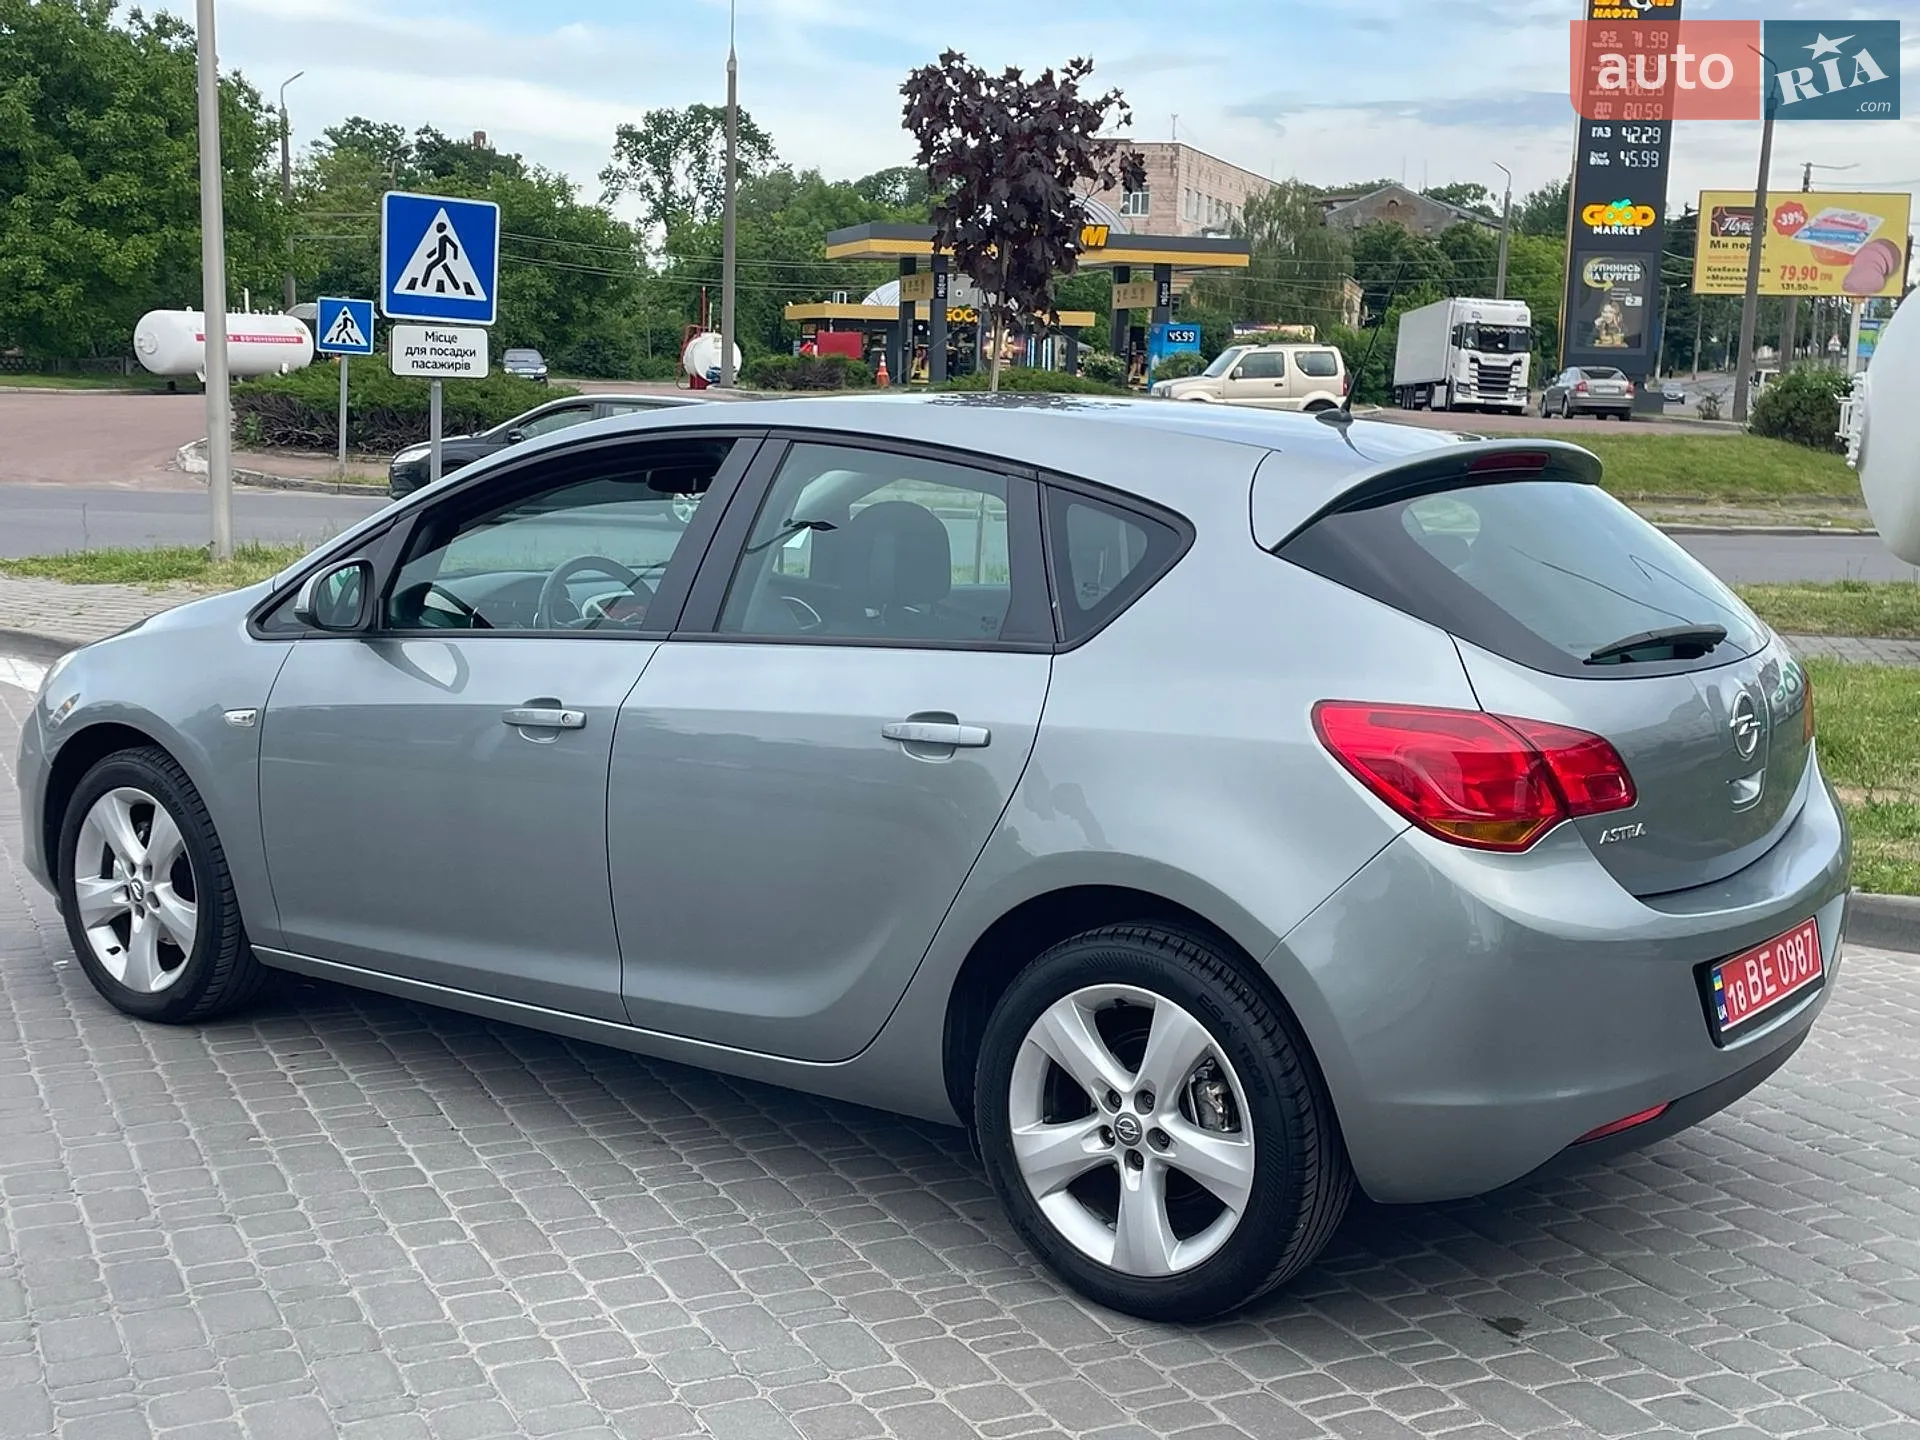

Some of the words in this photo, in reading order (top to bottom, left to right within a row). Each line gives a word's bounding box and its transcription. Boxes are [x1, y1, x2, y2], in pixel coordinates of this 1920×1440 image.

[1593, 7, 1639, 19] НАФТА
[1591, 126, 1611, 138] ГАЗ
[1621, 126, 1661, 144] 42.29
[1620, 150, 1659, 167] 45.99
[1582, 204, 1656, 227] GOOD
[1777, 211, 1805, 225] -39%
[1592, 225, 1643, 235] MARKET
[424, 331, 458, 344] Місце
[405, 346, 427, 356] для
[429, 347, 476, 358] посадки
[411, 360, 471, 372] пасажирів
[1599, 822, 1647, 844] ASTRA
[1728, 980, 1747, 1016] 18
[1745, 951, 1777, 1005] BE
[1776, 928, 1813, 986] 0987
[1717, 1004, 1728, 1020] UA
